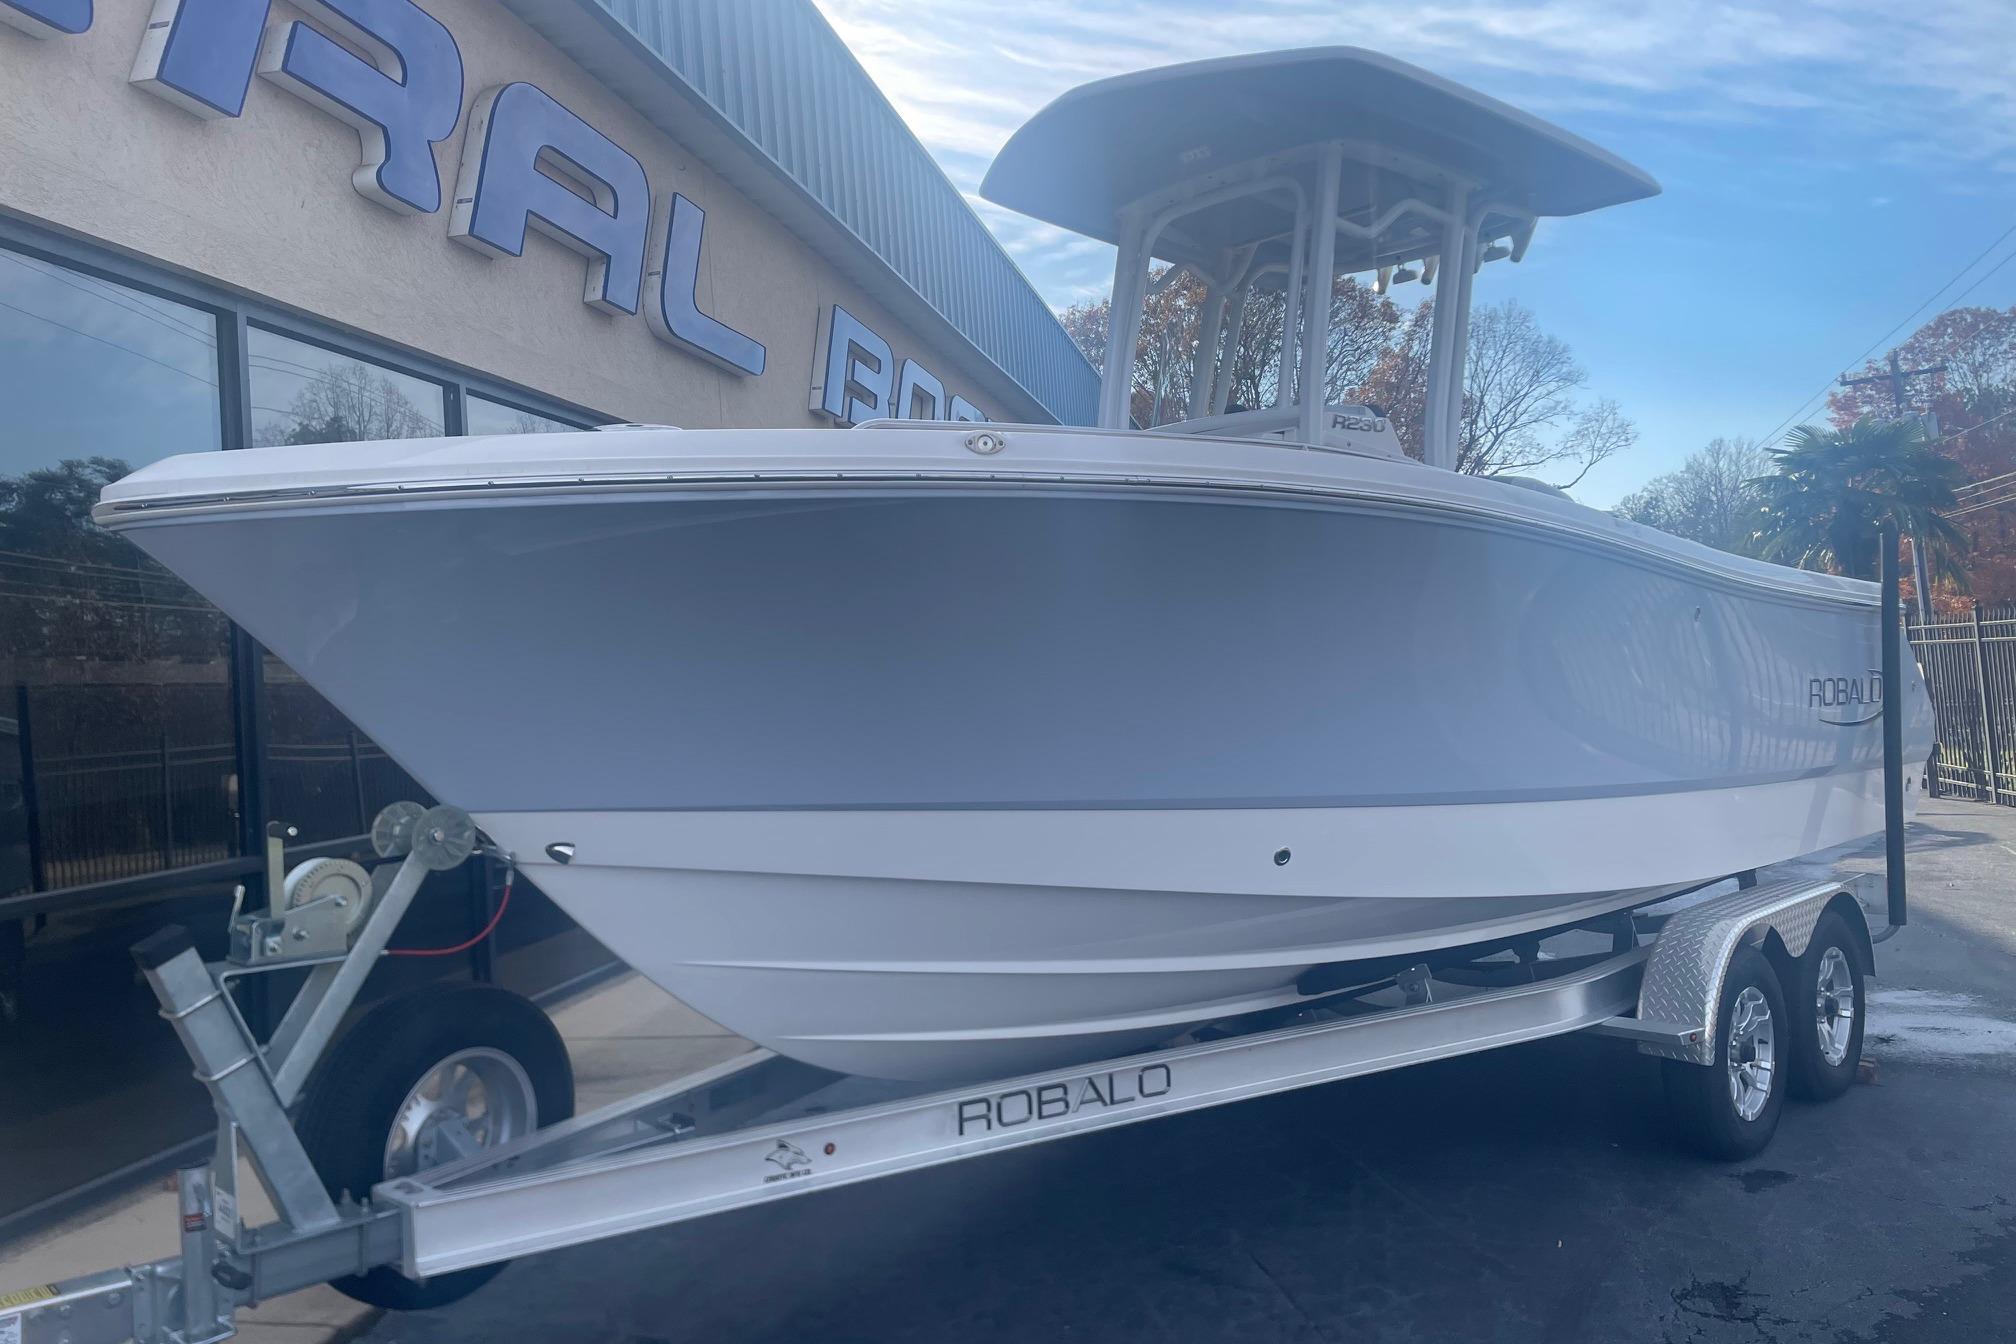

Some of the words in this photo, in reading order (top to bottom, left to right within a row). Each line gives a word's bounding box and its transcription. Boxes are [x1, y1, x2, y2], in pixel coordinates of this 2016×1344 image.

[0, 0, 766, 377] RAL
[1331, 414, 1386, 432] R230
[1809, 677, 1882, 708] ROBALO
[958, 1063, 1171, 1136] ROBALO
